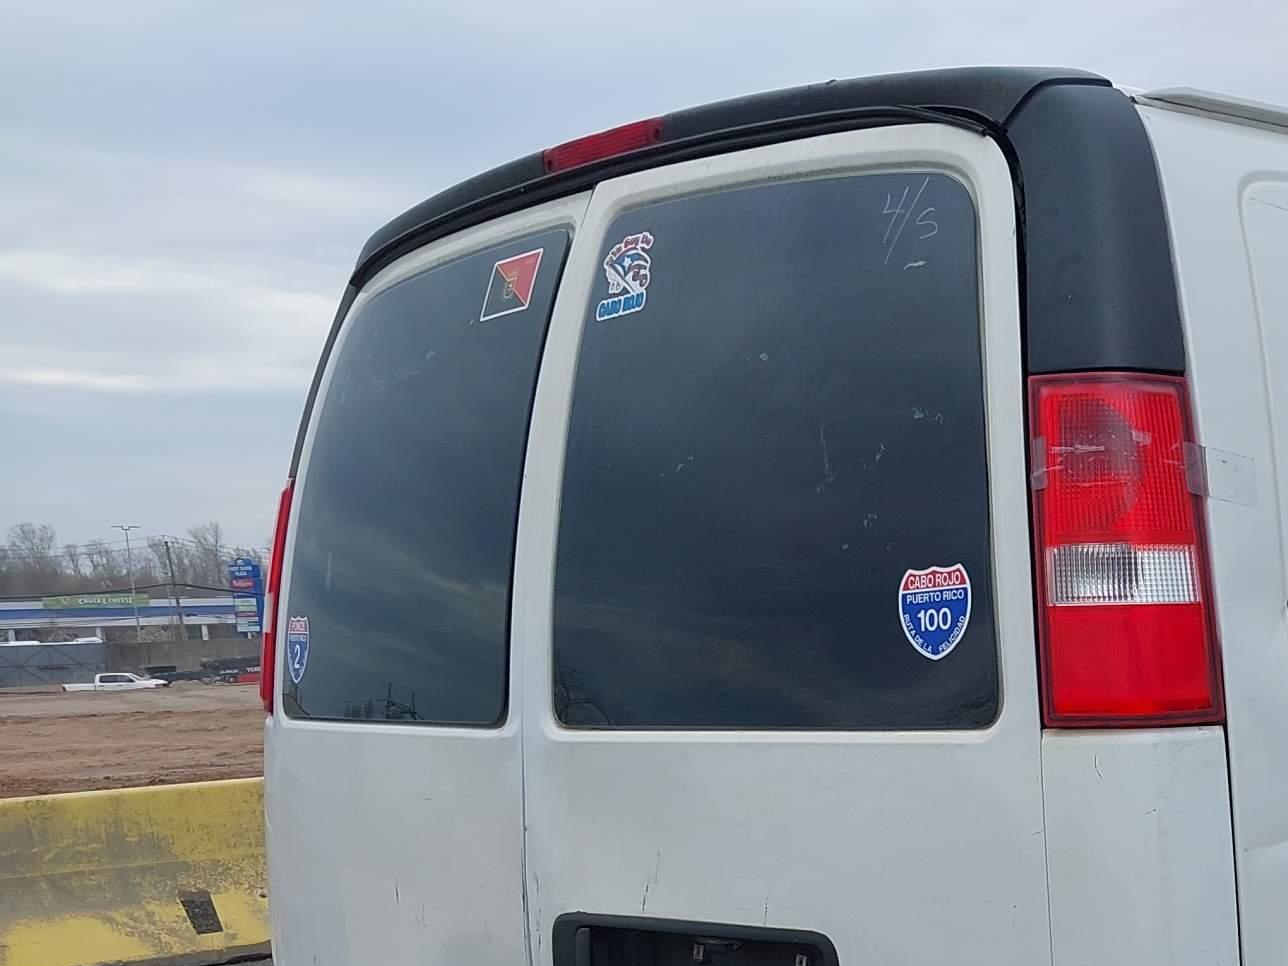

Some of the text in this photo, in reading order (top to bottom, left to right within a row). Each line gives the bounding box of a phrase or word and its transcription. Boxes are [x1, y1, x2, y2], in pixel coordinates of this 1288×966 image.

[907, 571, 961, 590] CABO ROJO
[906, 589, 965, 605] PUERTO RICO
[917, 607, 952, 632] 100
[903, 613, 933, 653] RUTA DE LA
[938, 615, 966, 653] FELICIDAD
[294, 644, 301, 669] 2
